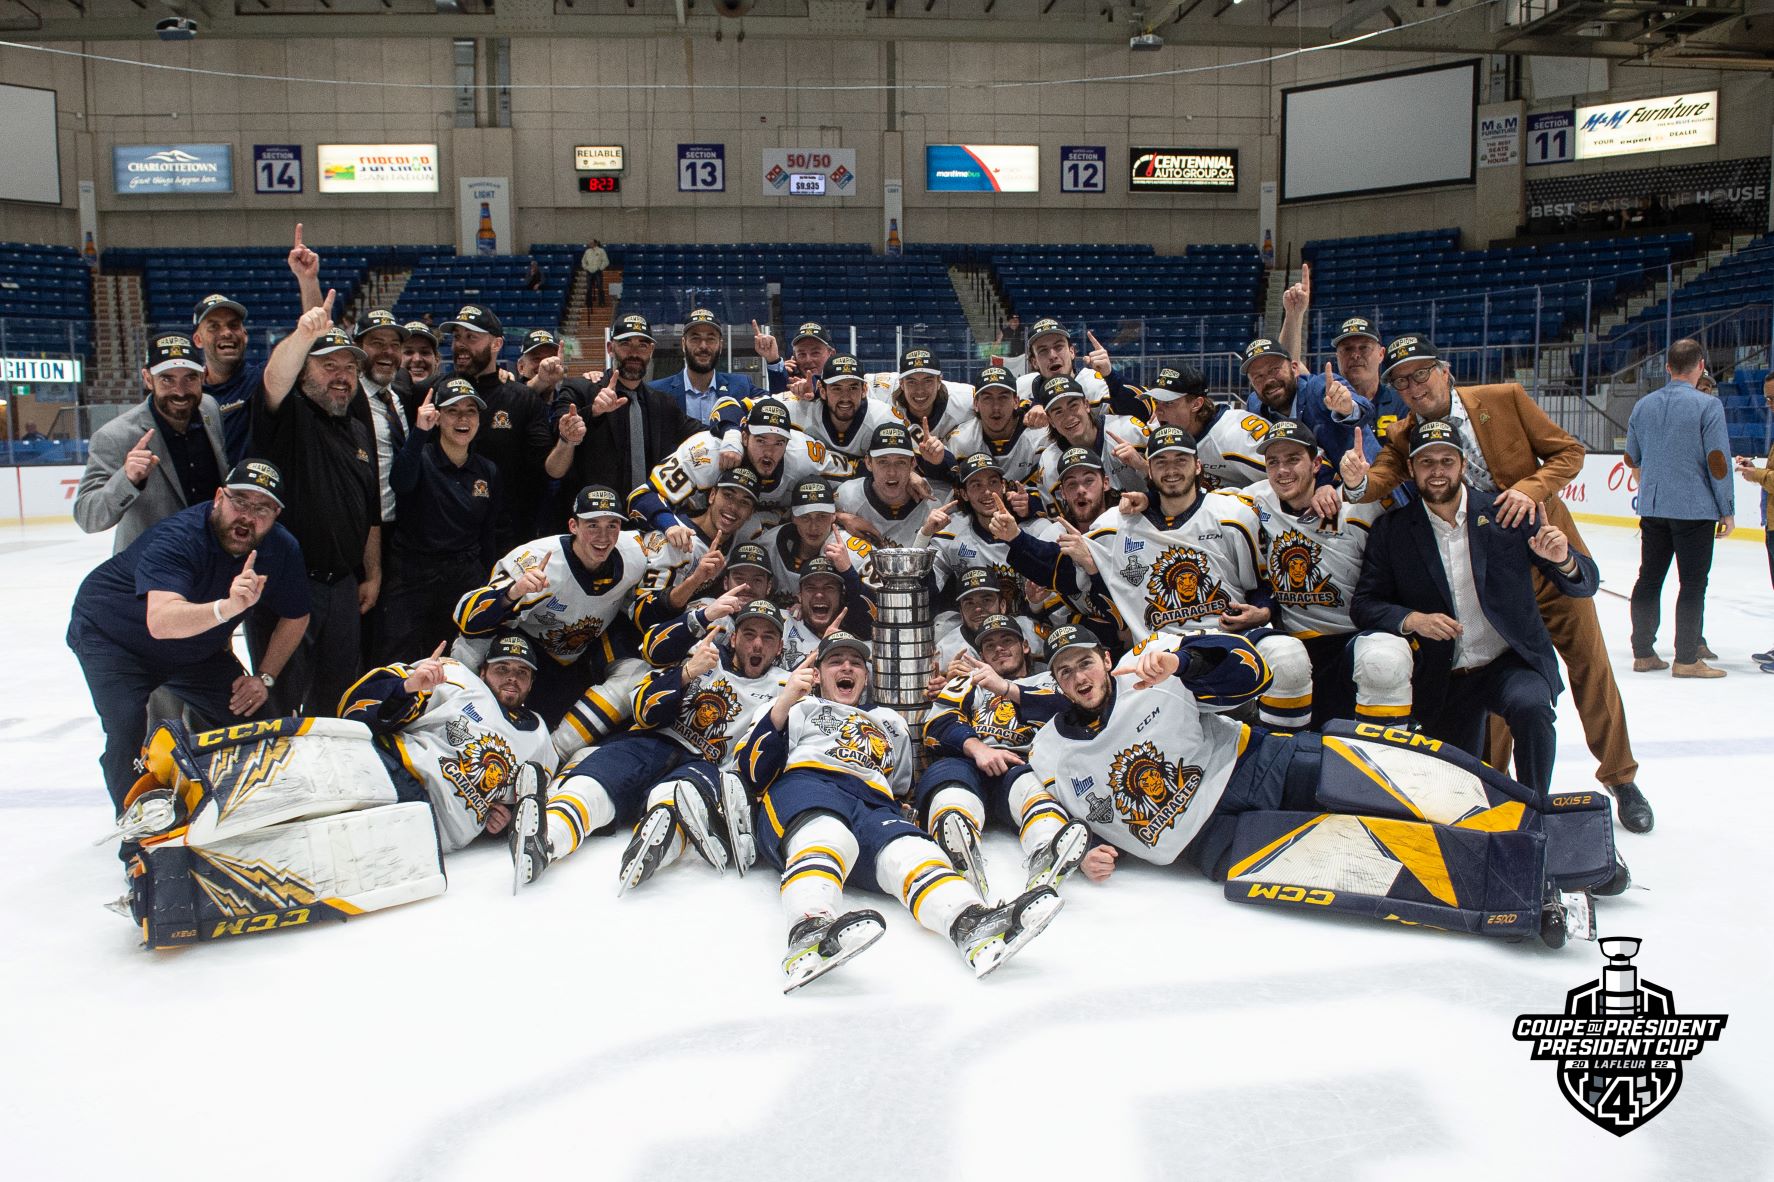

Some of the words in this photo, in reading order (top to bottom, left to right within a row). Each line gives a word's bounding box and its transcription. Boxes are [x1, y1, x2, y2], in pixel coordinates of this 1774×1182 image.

[1626, 97, 1710, 124] Furniture
[1482, 121, 1494, 131] M
[1505, 117, 1518, 128] M
[1534, 119, 1569, 130] SECTION
[1535, 129, 1567, 160] 11
[1620, 137, 1652, 146] expert
[262, 152, 294, 160] SECTION
[577, 149, 621, 158] RELIABLE
[686, 151, 717, 159] SECTION
[787, 153, 831, 169] 50/50
[1154, 155, 1234, 169] CENTENNIAL
[128, 162, 217, 172] CHARLOTTETOWN
[261, 162, 295, 188] 14
[685, 161, 717, 187] 13
[1068, 163, 1098, 188] 12
[474, 190, 495, 199] LIGHT
[589, 177, 614, 191] 8:23
[1531, 203, 1575, 218] BEST
[1578, 198, 1630, 214] SEATS
[0, 361, 65, 379] GHTON
[1241, 415, 1270, 442] S
[652, 458, 688, 493] 29
[847, 536, 872, 559] S
[1198, 533, 1223, 541] CCM
[1274, 591, 1335, 604] ATARACTES
[1151, 598, 1226, 627] CATARACTES
[947, 676, 970, 694] 2
[883, 720, 900, 738] CCM
[1136, 706, 1160, 733] CCM
[197, 719, 282, 747] CCM
[673, 721, 721, 760] TARACTES
[1353, 723, 1443, 753] CCM
[442, 761, 489, 815] CATARACT
[1138, 774, 1201, 844] CATARACTES
[1247, 883, 1336, 906] CCM
[212, 908, 311, 939] CCM
